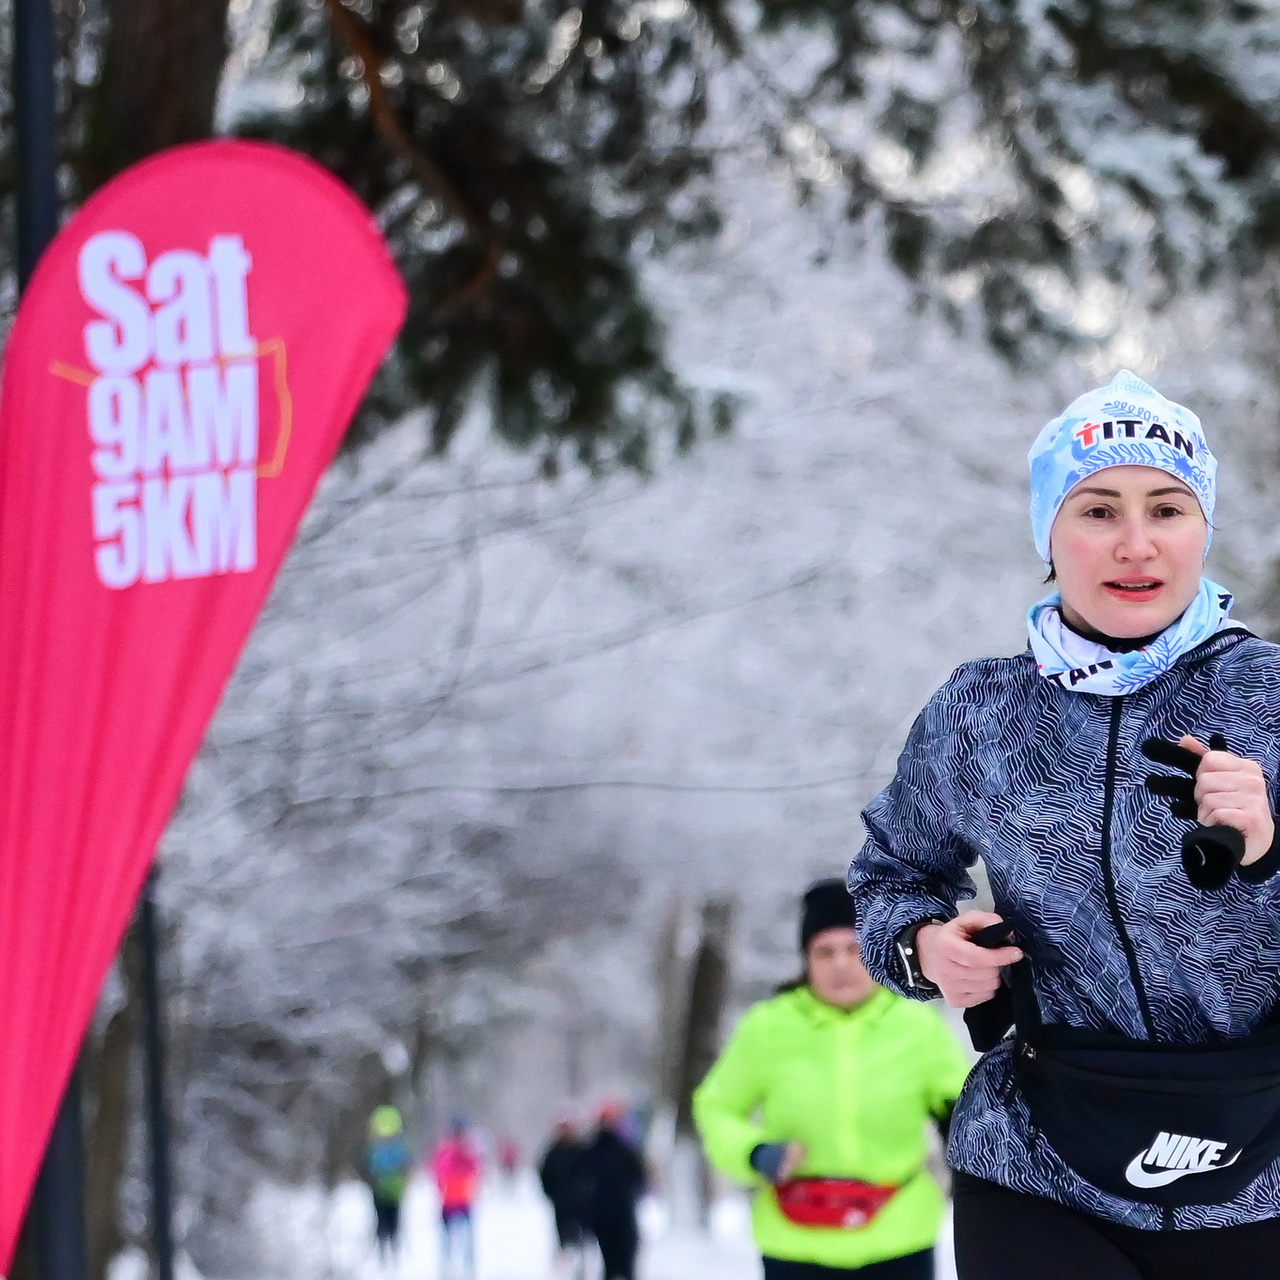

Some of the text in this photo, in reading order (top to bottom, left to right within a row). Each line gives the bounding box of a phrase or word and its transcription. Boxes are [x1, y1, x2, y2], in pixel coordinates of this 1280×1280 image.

[78, 230, 257, 374] Sat
[87, 363, 259, 477] 9AM
[1076, 420, 1194, 460] TITAN
[91, 470, 257, 590] 5KM
[1143, 1131, 1228, 1170] NIKE
